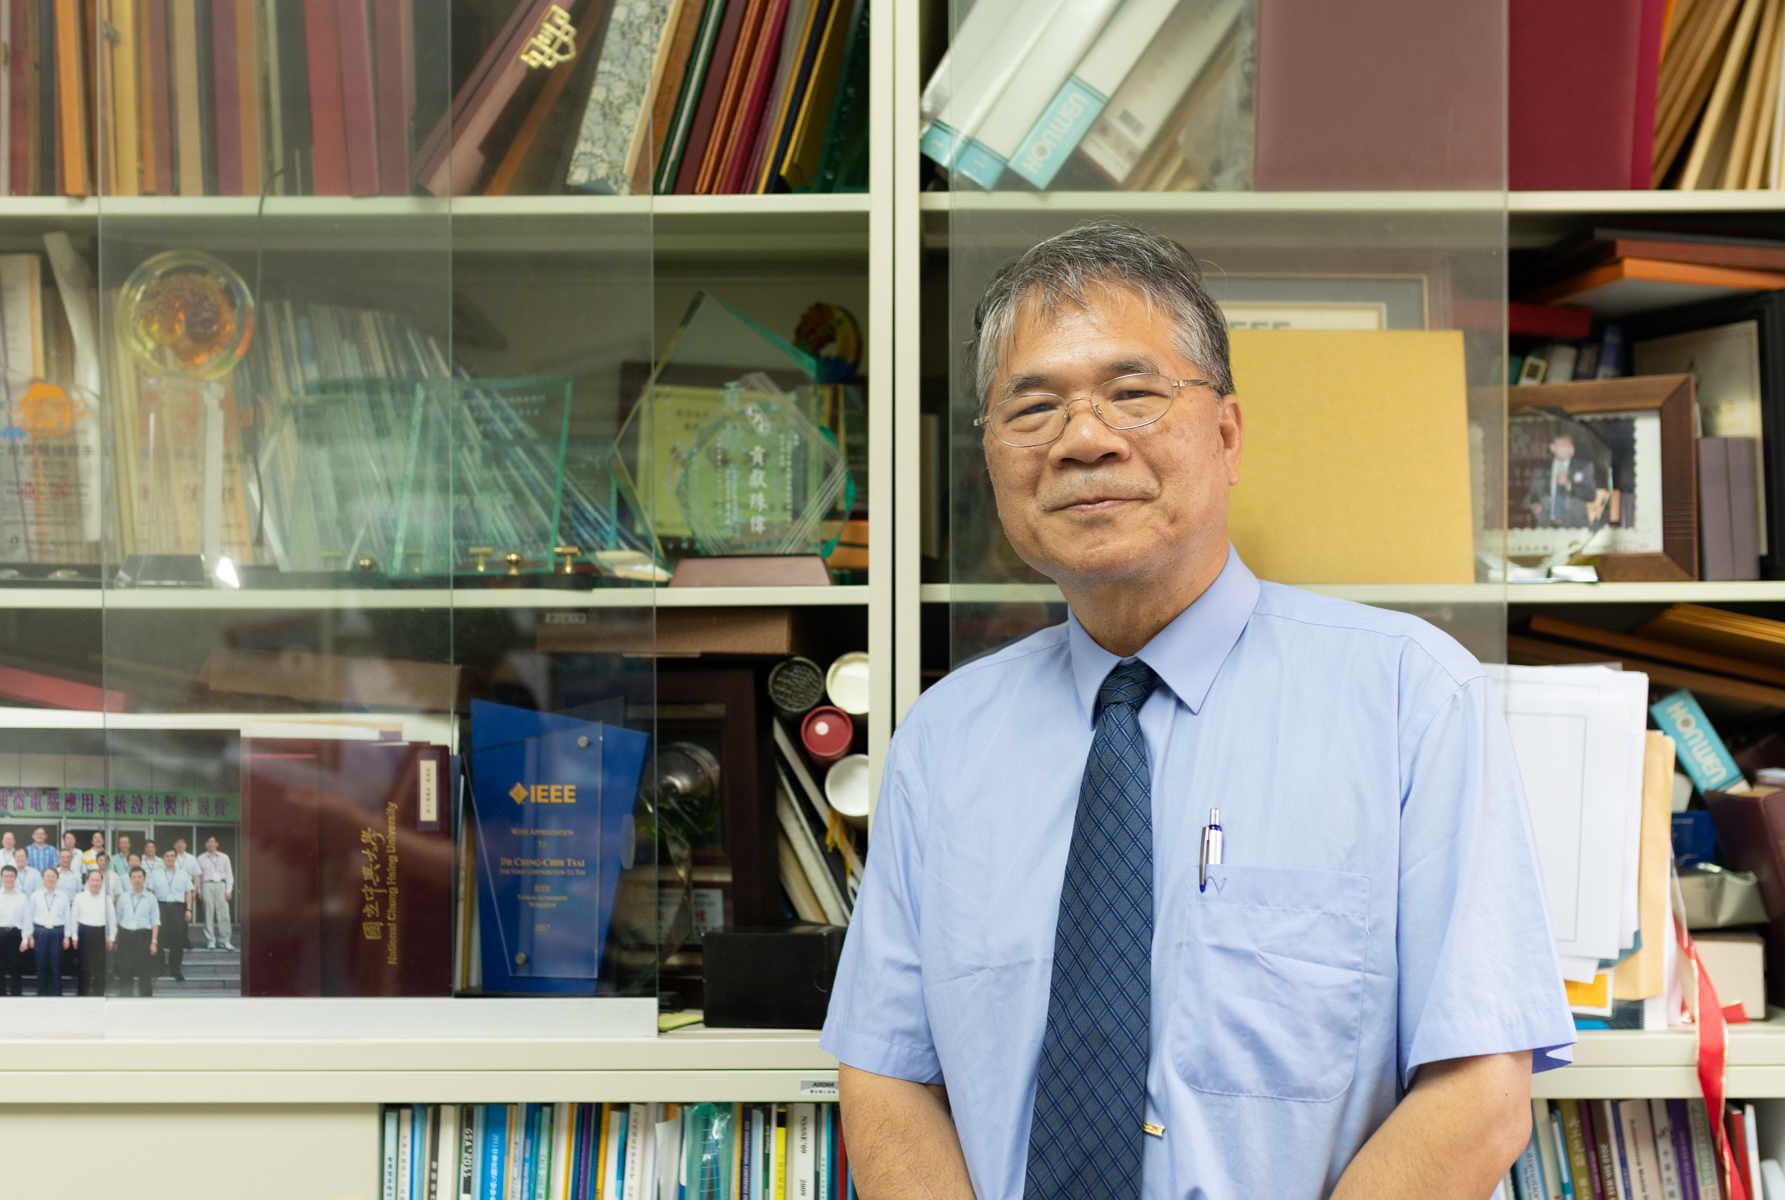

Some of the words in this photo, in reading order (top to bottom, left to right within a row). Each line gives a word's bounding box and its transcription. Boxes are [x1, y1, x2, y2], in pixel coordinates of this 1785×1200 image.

[530, 784, 577, 804] IEEE
[386, 801, 399, 853] University
[386, 855, 398, 885] Hsing
[387, 887, 399, 921] Chung
[387, 923, 398, 965] National
[799, 1179, 808, 1197] 2009
